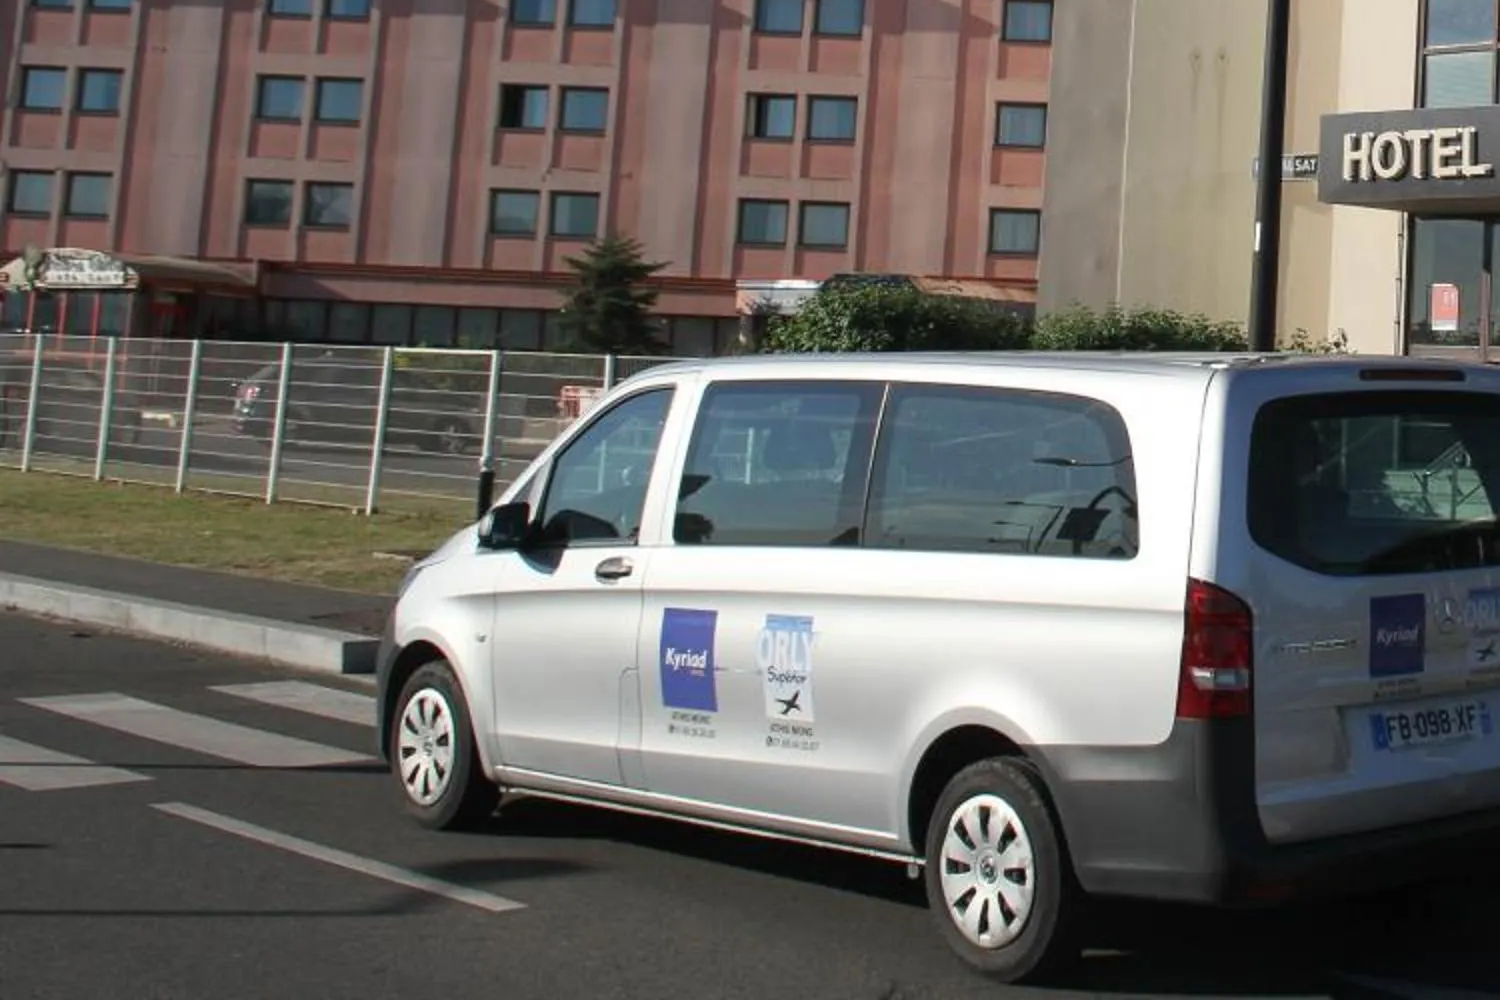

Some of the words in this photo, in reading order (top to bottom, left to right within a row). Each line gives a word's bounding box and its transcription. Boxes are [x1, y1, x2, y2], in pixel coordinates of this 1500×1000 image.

[1342, 125, 1493, 182] HOTEL
[757, 630, 819, 672] ORLY
[1376, 625, 1420, 646] Kyriad
[665, 647, 708, 671] Kyriad
